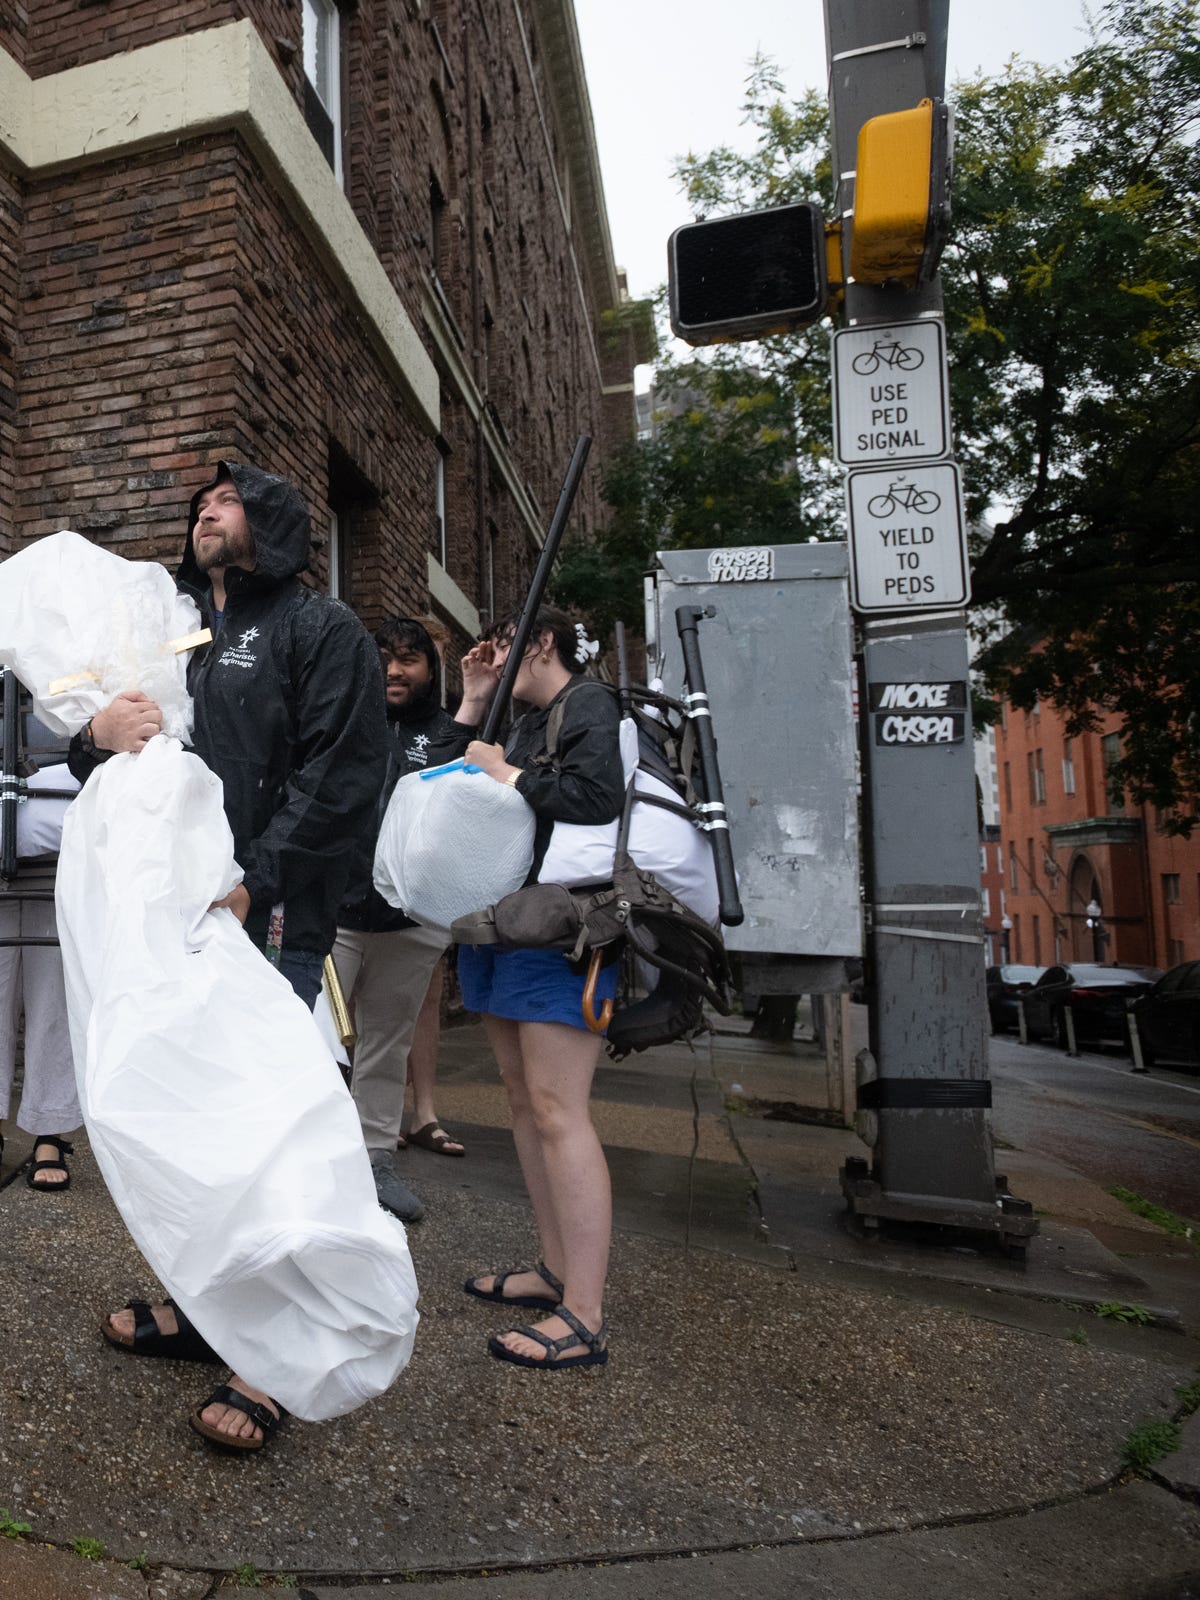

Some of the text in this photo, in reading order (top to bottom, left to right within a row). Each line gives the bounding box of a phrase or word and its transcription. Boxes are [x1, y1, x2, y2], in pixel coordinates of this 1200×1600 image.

[870, 383, 908, 403] USE
[871, 407, 908, 426] PED
[857, 429, 925, 452] SIGNAL
[878, 526, 935, 547] YIELD
[896, 551, 920, 570] TO
[884, 575, 935, 596] PEDS
[880, 684, 950, 709] MOKE
